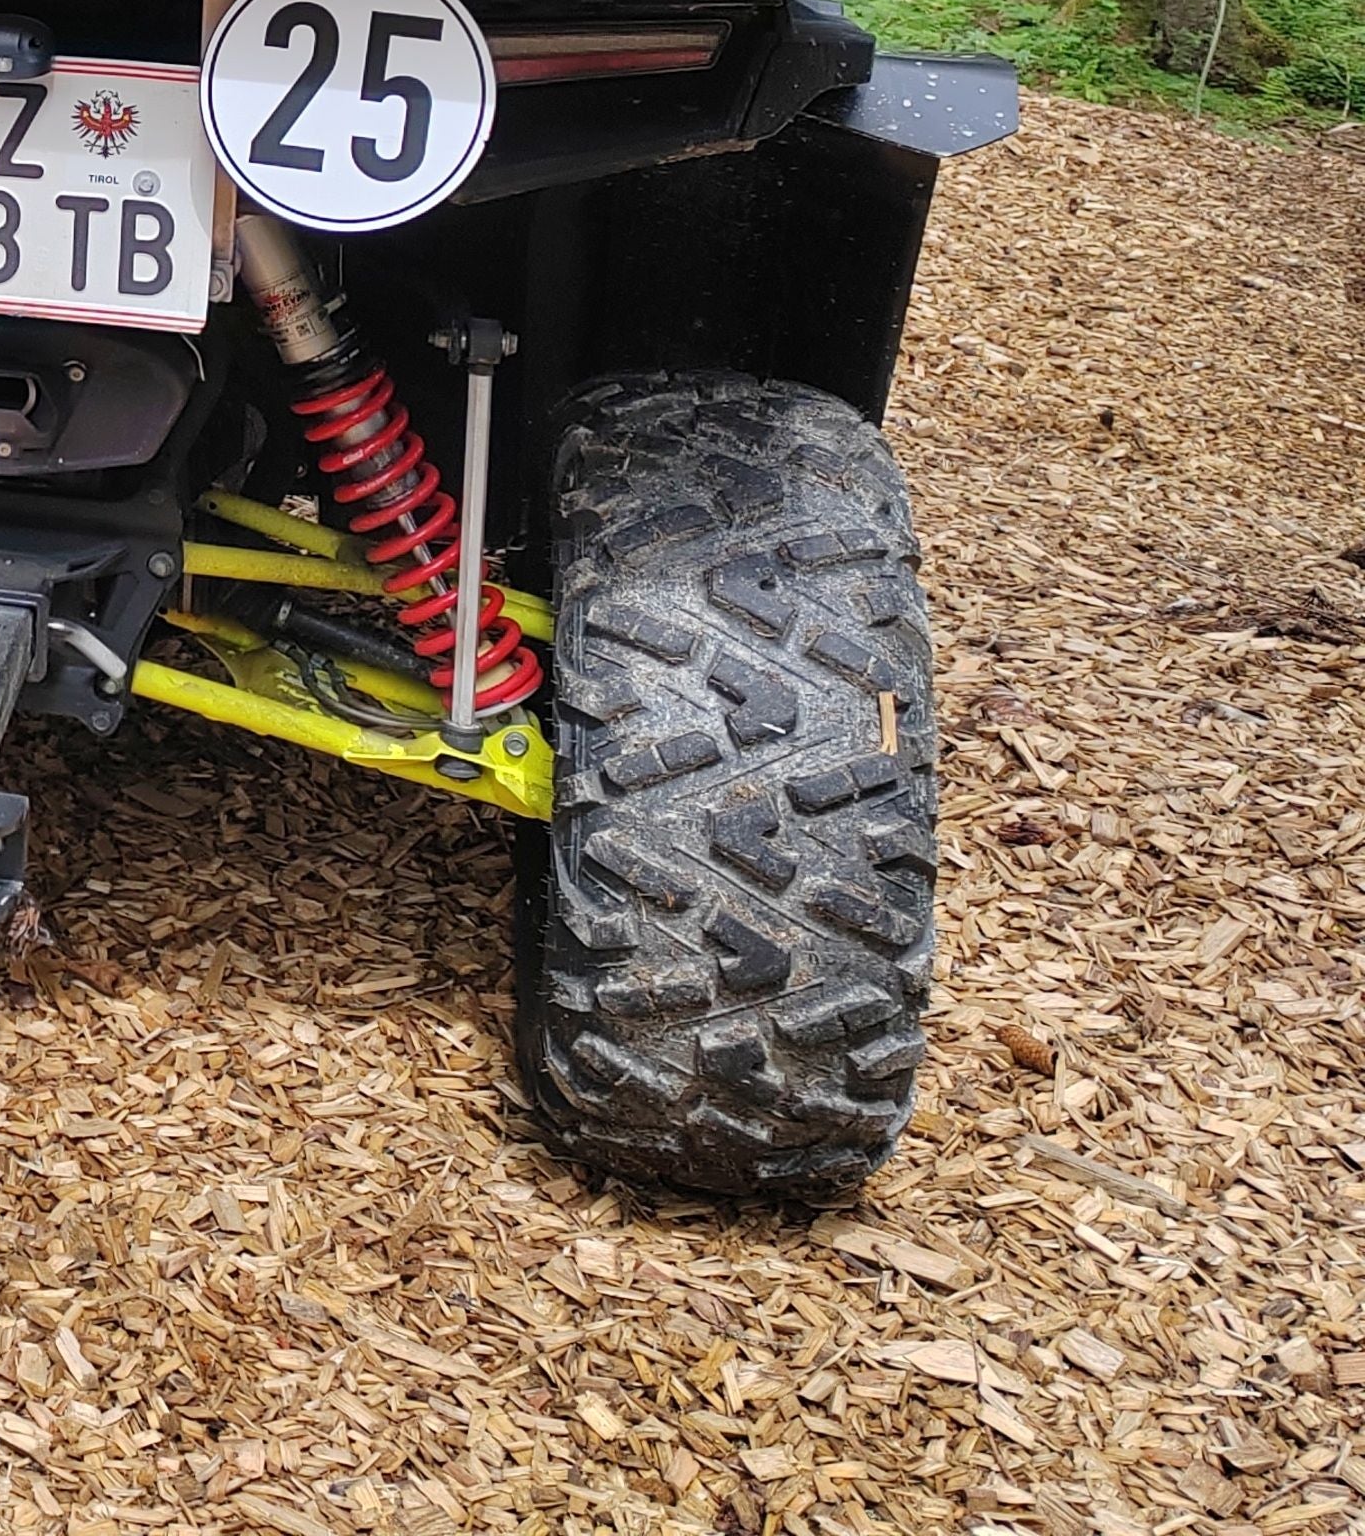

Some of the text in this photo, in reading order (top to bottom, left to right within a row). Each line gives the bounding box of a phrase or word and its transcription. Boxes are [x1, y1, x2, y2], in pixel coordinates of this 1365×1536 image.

[248, 1, 445, 183] 25
[88, 174, 120, 185] TIROL
[55, 194, 175, 296] TB
